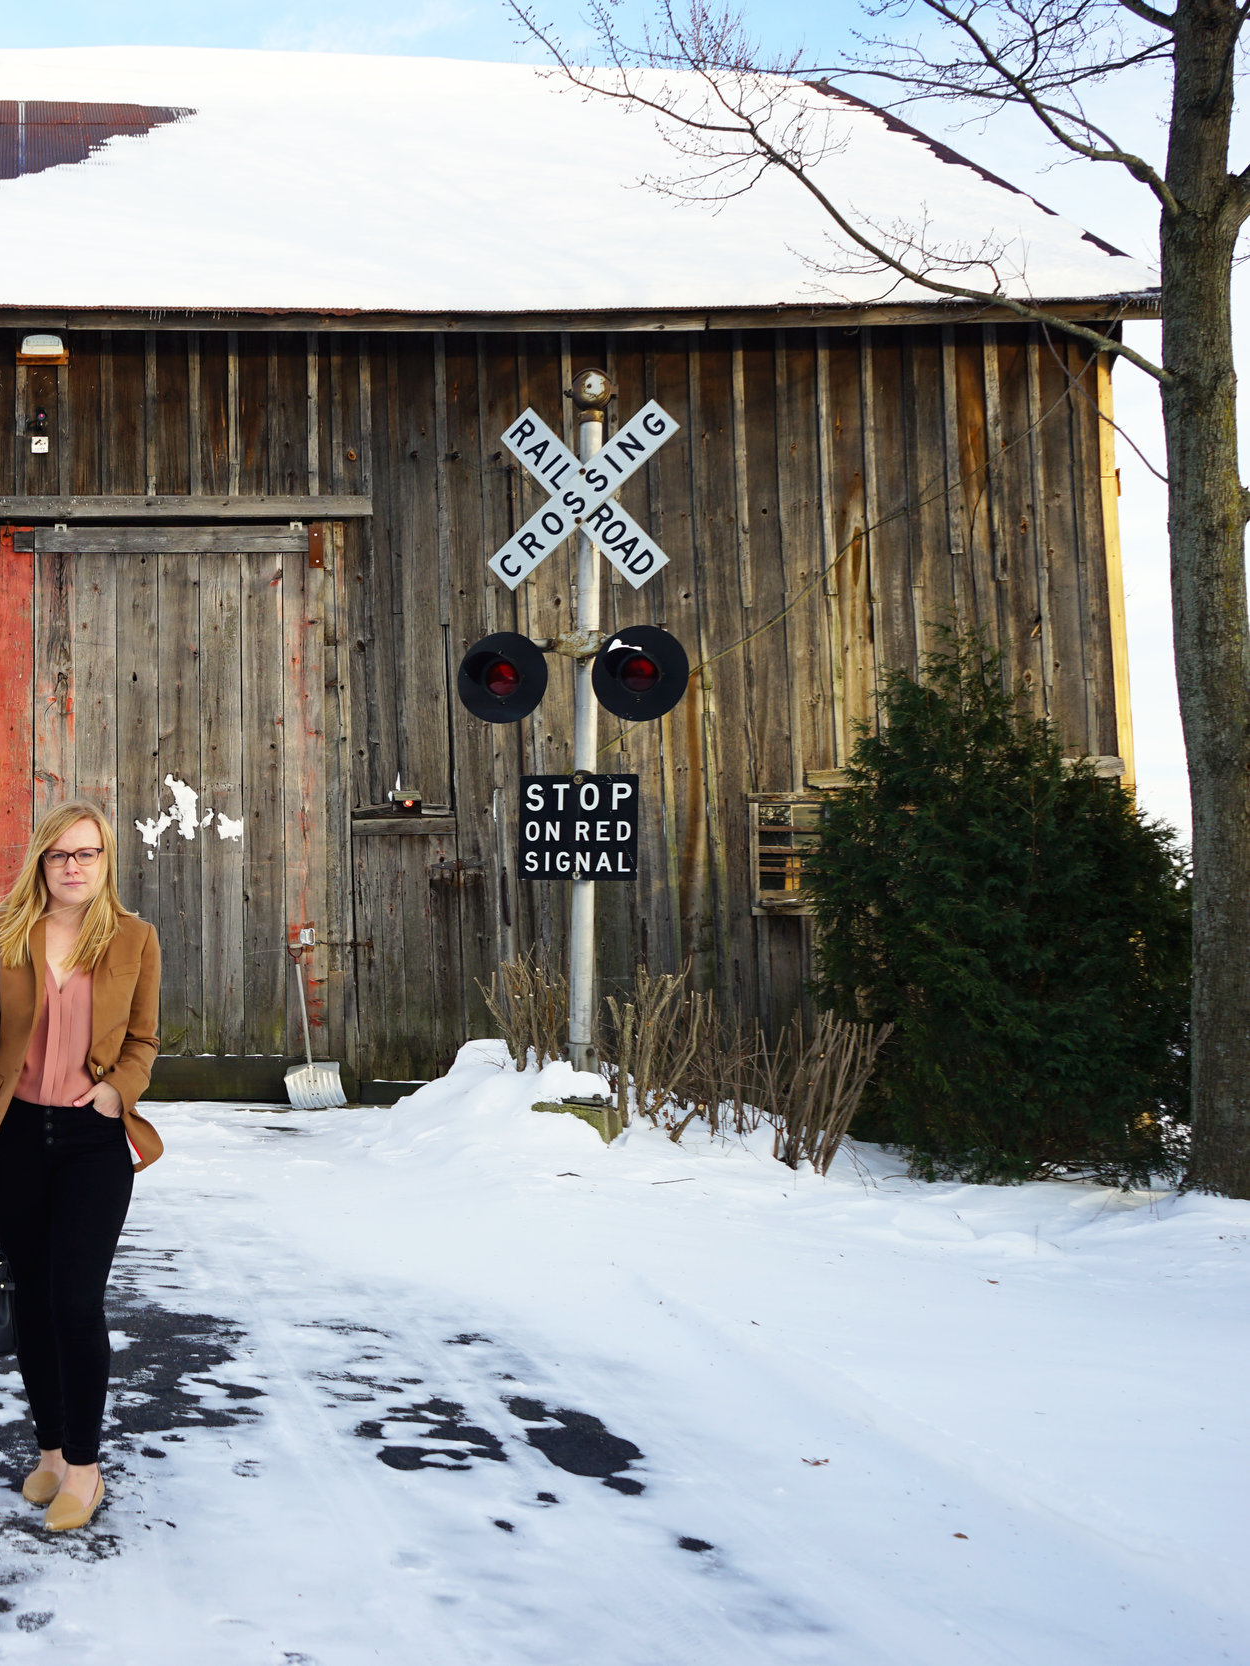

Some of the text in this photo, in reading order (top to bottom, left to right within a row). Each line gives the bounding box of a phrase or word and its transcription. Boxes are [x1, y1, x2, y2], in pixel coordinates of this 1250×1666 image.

[500, 412, 666, 578] CROSSING
[525, 783, 632, 811] STOP
[525, 821, 631, 841] ON RED
[525, 851, 630, 872] SIGNAL
